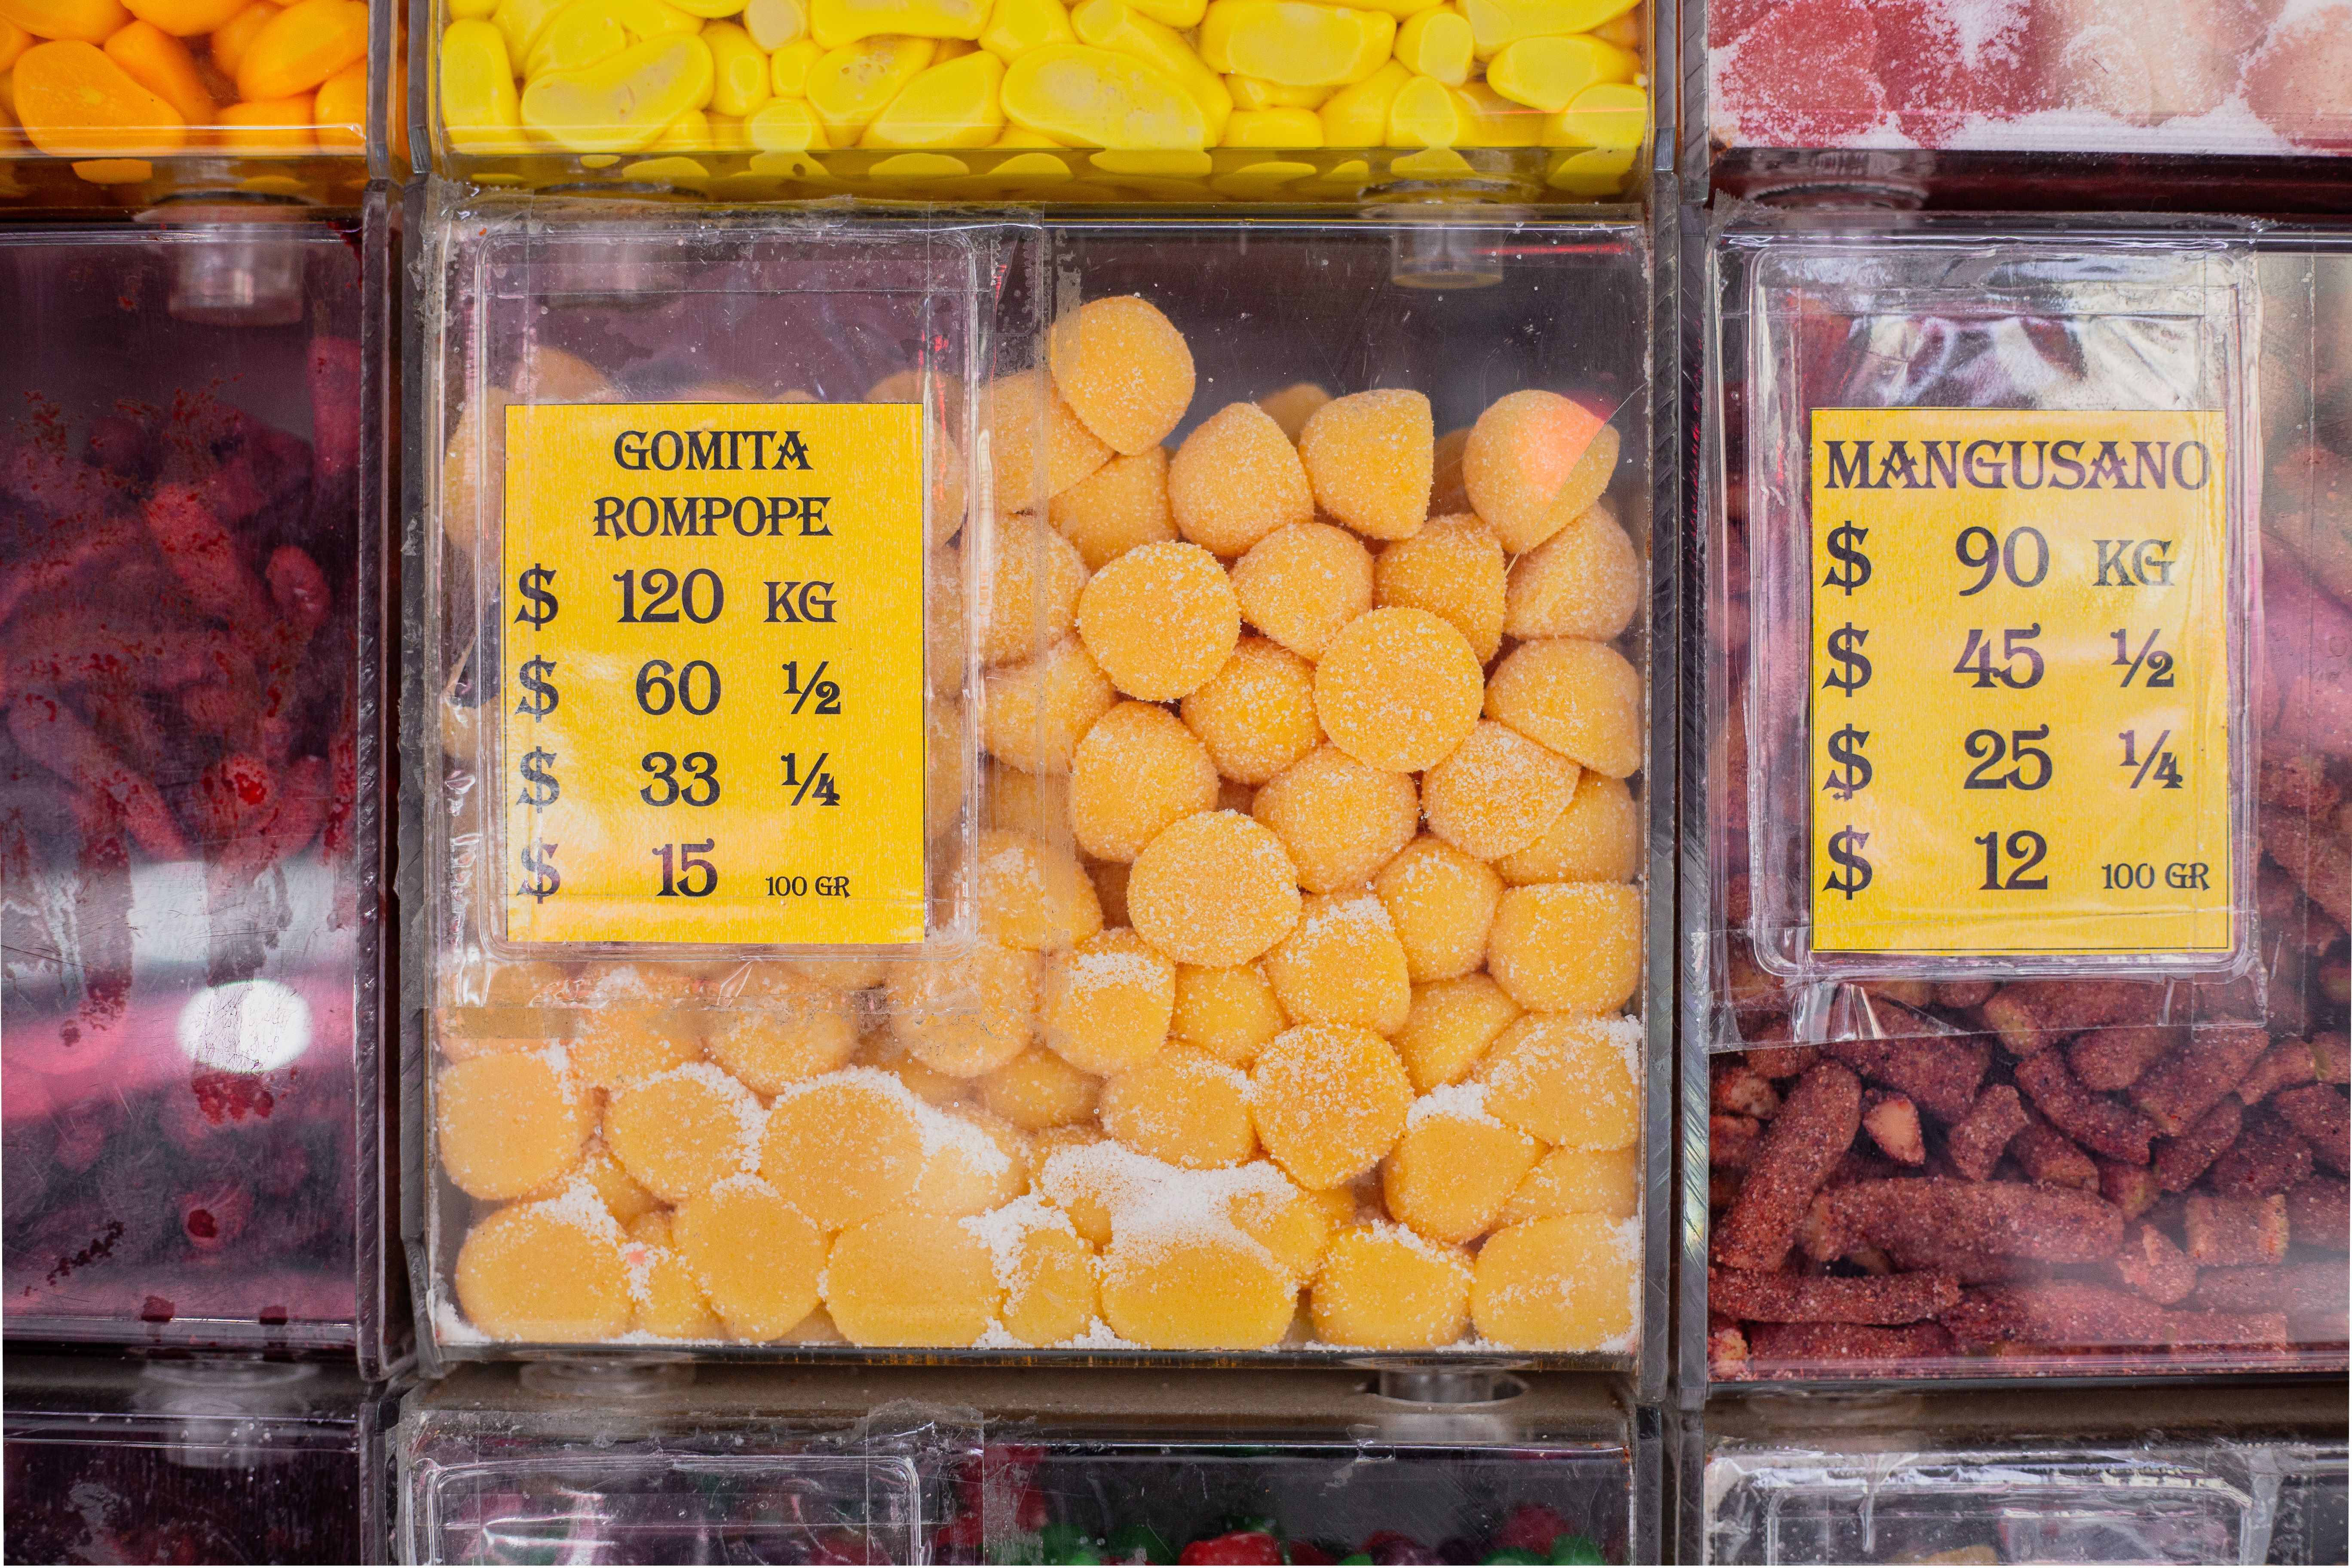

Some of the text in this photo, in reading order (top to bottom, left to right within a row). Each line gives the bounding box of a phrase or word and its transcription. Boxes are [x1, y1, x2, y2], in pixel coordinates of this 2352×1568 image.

[614, 430, 814, 471] GOMITA
[1823, 440, 2212, 490] MANGUSANO
[593, 496, 833, 541] ROMPOPE
[1822, 521, 2175, 596] $ 90 KG
[514, 564, 837, 631] $ 120 KG
[515, 655, 559, 723] $
[636, 660, 721, 715] 60
[1822, 622, 1872, 697] $
[1953, 623, 2044, 689] 45
[516, 746, 560, 813] $
[640, 752, 720, 806] 33
[1822, 723, 1872, 801] $
[1964, 724, 2052, 790] 25
[517, 838, 850, 903] $ 15 100 GR
[1822, 825, 2210, 900] $ 12 100 GR
